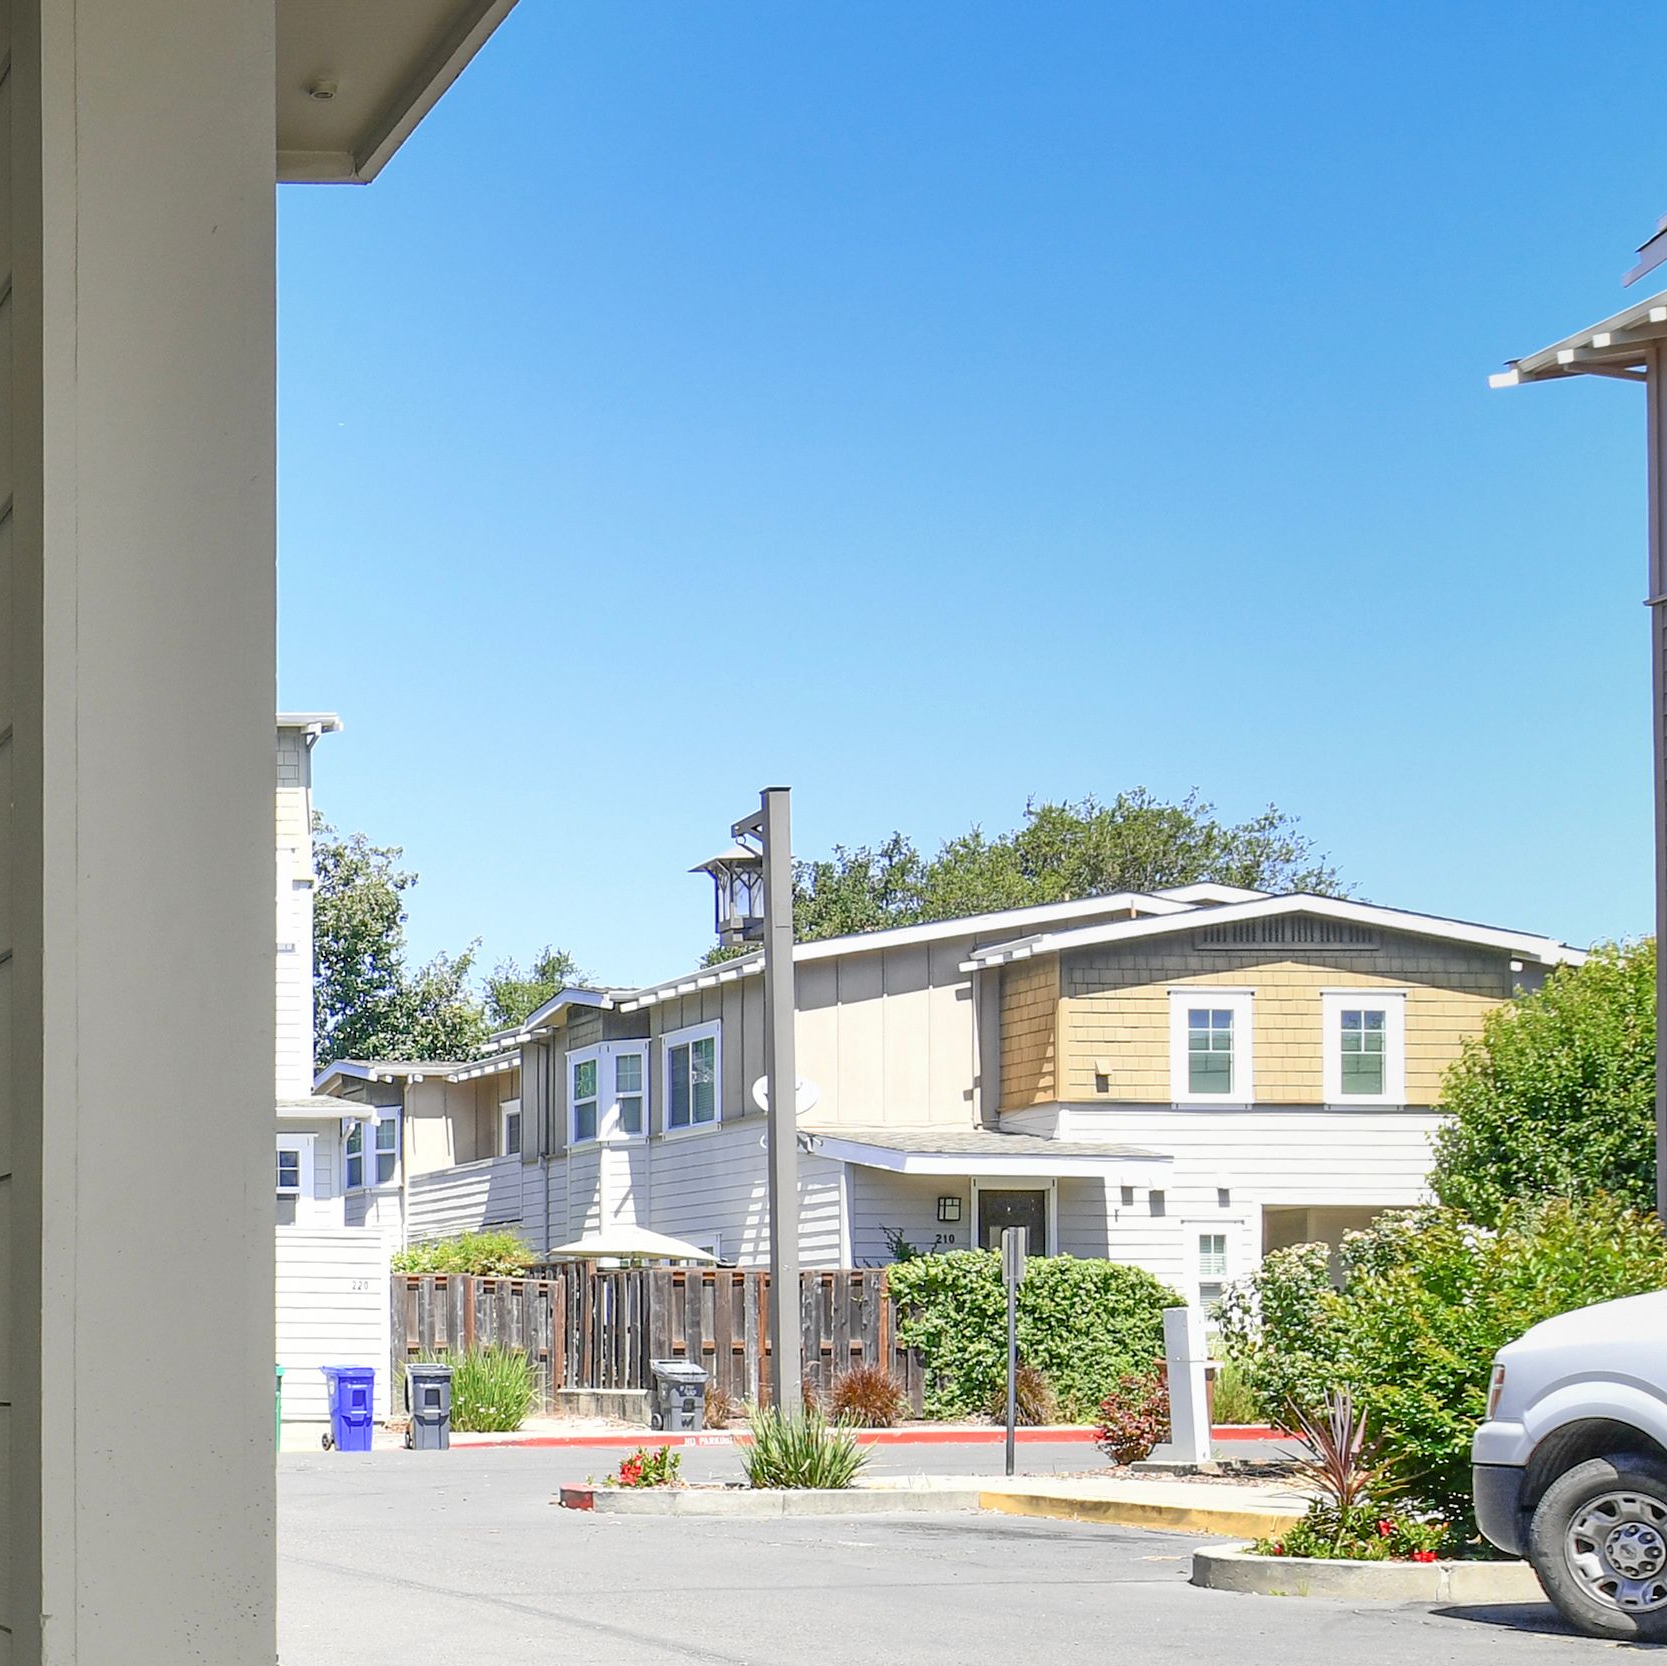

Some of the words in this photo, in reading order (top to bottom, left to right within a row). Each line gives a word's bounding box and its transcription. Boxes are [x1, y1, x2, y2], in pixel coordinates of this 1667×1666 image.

[935, 1233, 955, 1244] 210
[352, 1280, 369, 1291] 220
[684, 1436, 696, 1447] NO
